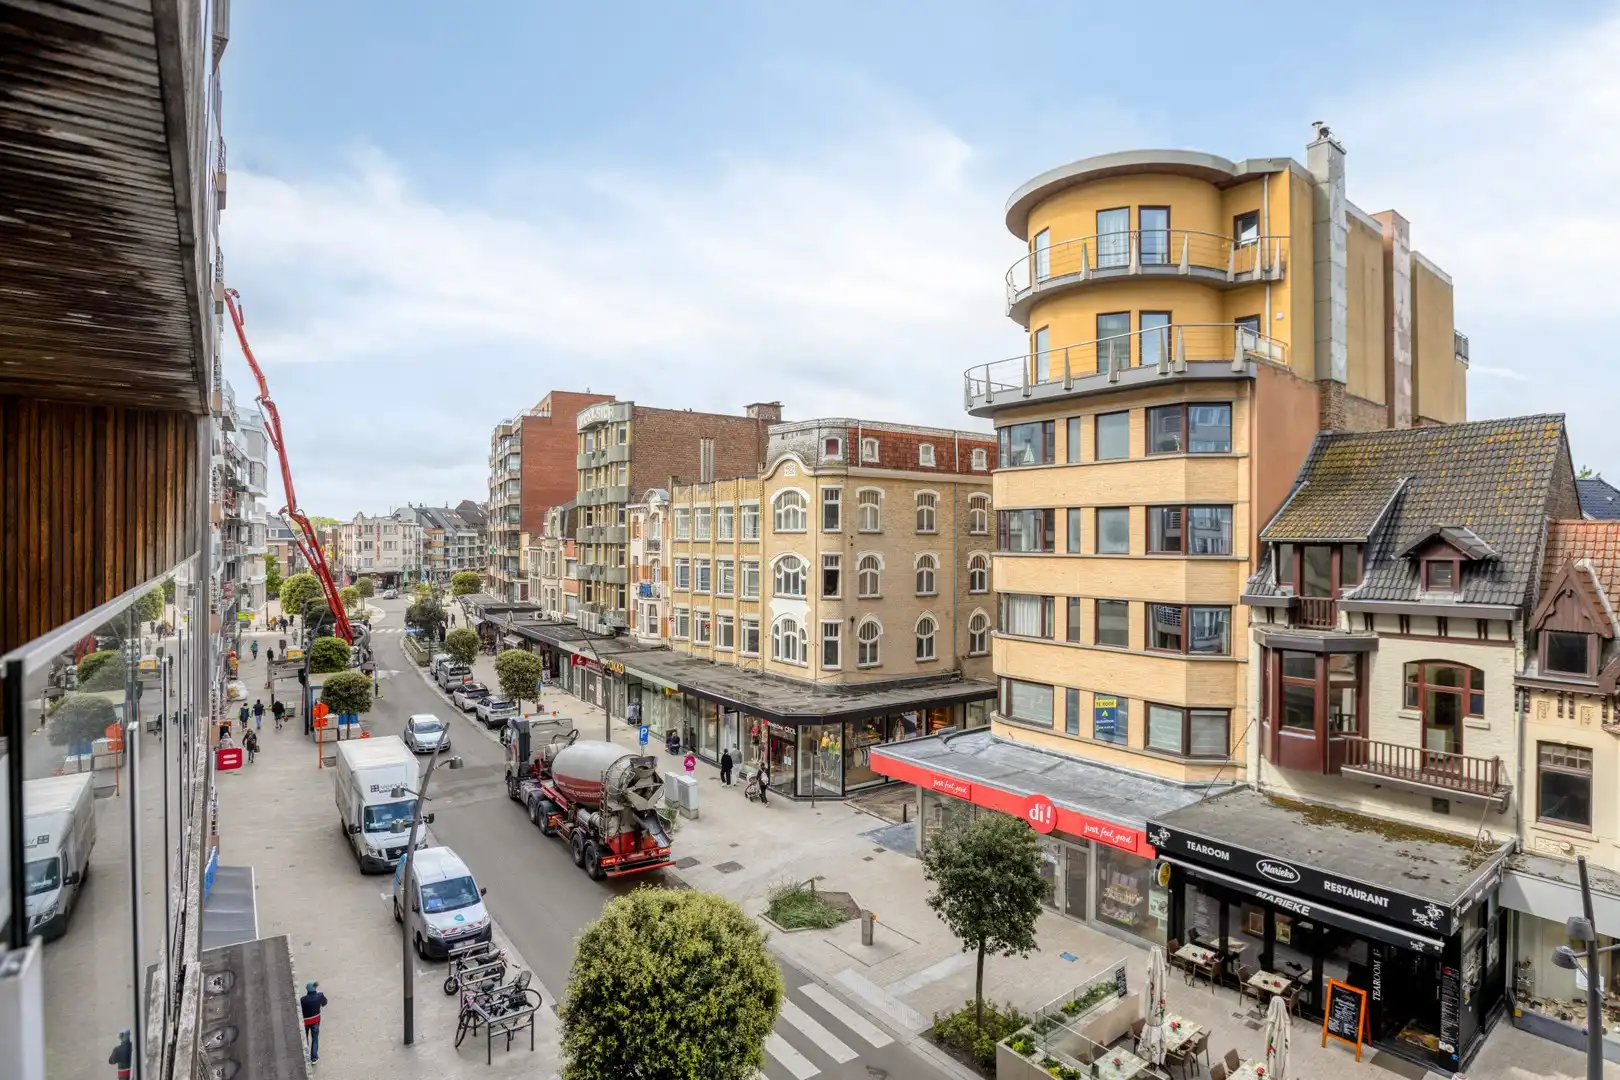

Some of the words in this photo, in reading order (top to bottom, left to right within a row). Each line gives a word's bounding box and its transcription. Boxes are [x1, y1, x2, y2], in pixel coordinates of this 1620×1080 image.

[640, 727, 648, 739] P
[1028, 803, 1052, 825] di!
[1083, 822, 1099, 834] just
[1099, 827, 1114, 839] feel
[1112, 834, 1133, 844] good
[1186, 840, 1230, 861] TEAROOM
[1261, 862, 1296, 880] Marieke
[1255, 891, 1311, 916] MARIEKE
[1323, 880, 1390, 908] RESTAURANT
[1372, 960, 1382, 1001] TEAROOM
